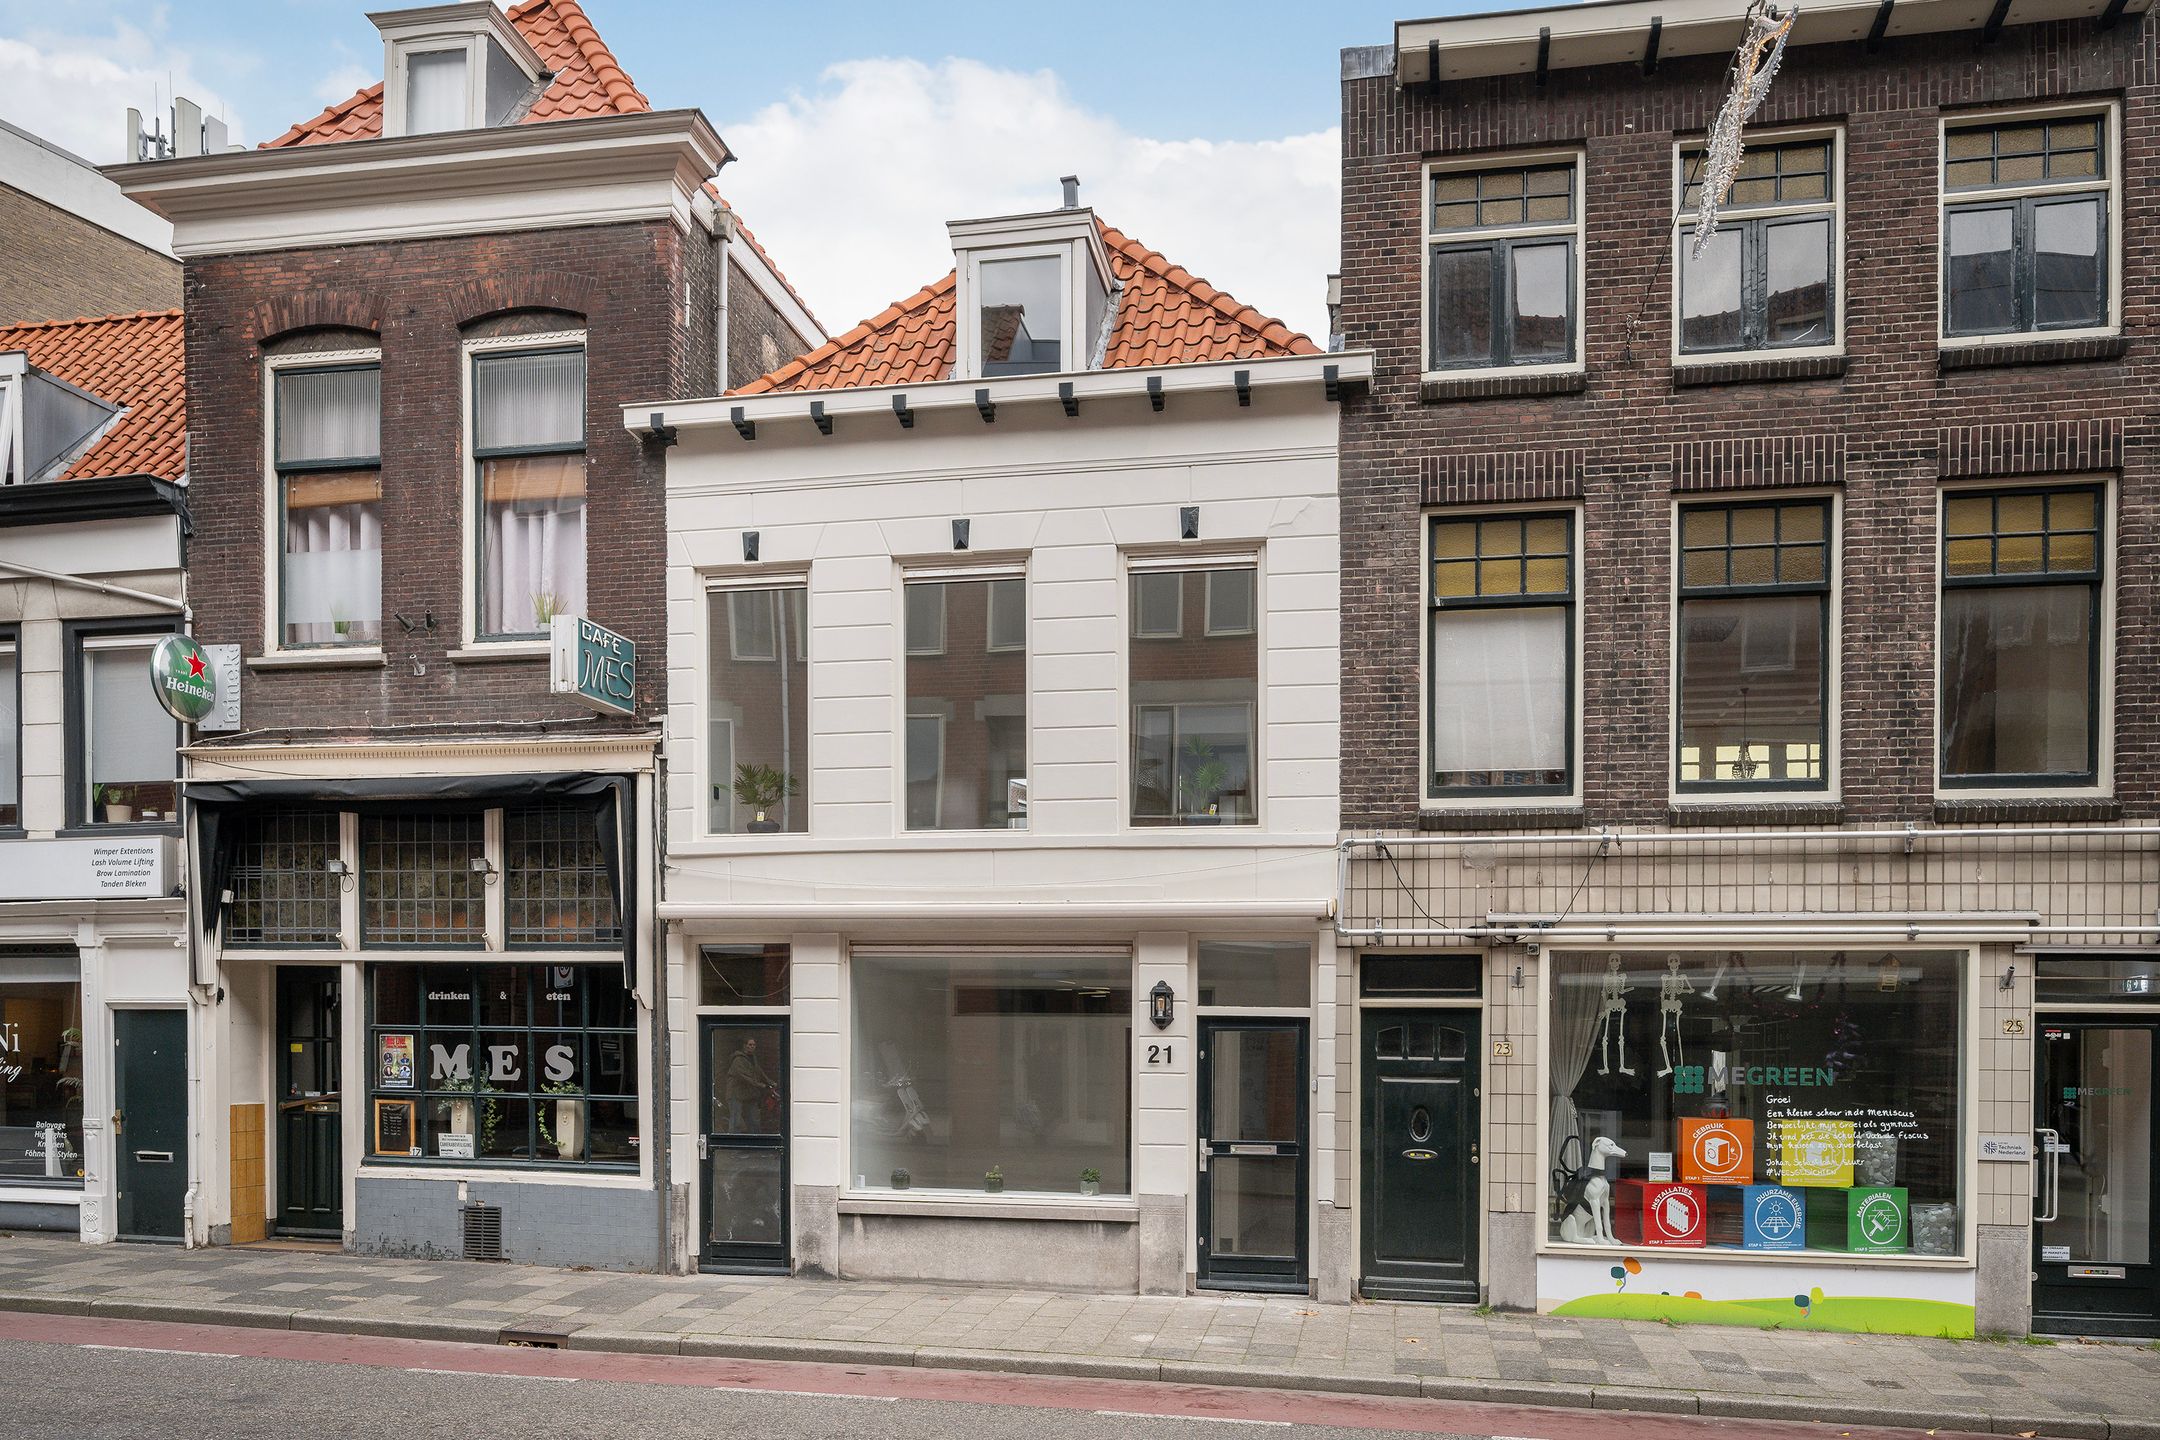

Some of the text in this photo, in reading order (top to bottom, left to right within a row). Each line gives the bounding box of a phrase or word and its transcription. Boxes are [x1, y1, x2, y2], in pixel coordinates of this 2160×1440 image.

[581, 622, 621, 655] CAFE
[579, 649, 634, 699] MES
[93, 847, 154, 856] Wimper Extentions
[133, 858, 154, 867] Lifting
[428, 991, 571, 1001] drinken & eten
[2006, 1020, 2023, 1033] 25
[1147, 1045, 1172, 1064] 21
[1496, 1043, 1511, 1055] 23
[1707, 1066, 1834, 1086] MEGREEN
[1766, 1094, 1791, 1104] Groei
[1767, 1109, 1785, 1118] Een
[1786, 1107, 1814, 1117] kleine
[1692, 1122, 1724, 1139] GEBRUIK
[1880, 1120, 1919, 1132] gymnast
[57, 1151, 78, 1160] Stylen
[412, 1148, 421, 1157] 17
[1651, 1186, 1693, 1210] INSTALLATIES
[1756, 1189, 1792, 1203] DUURZAME
[1856, 1192, 1892, 1217] MATERIALEN
